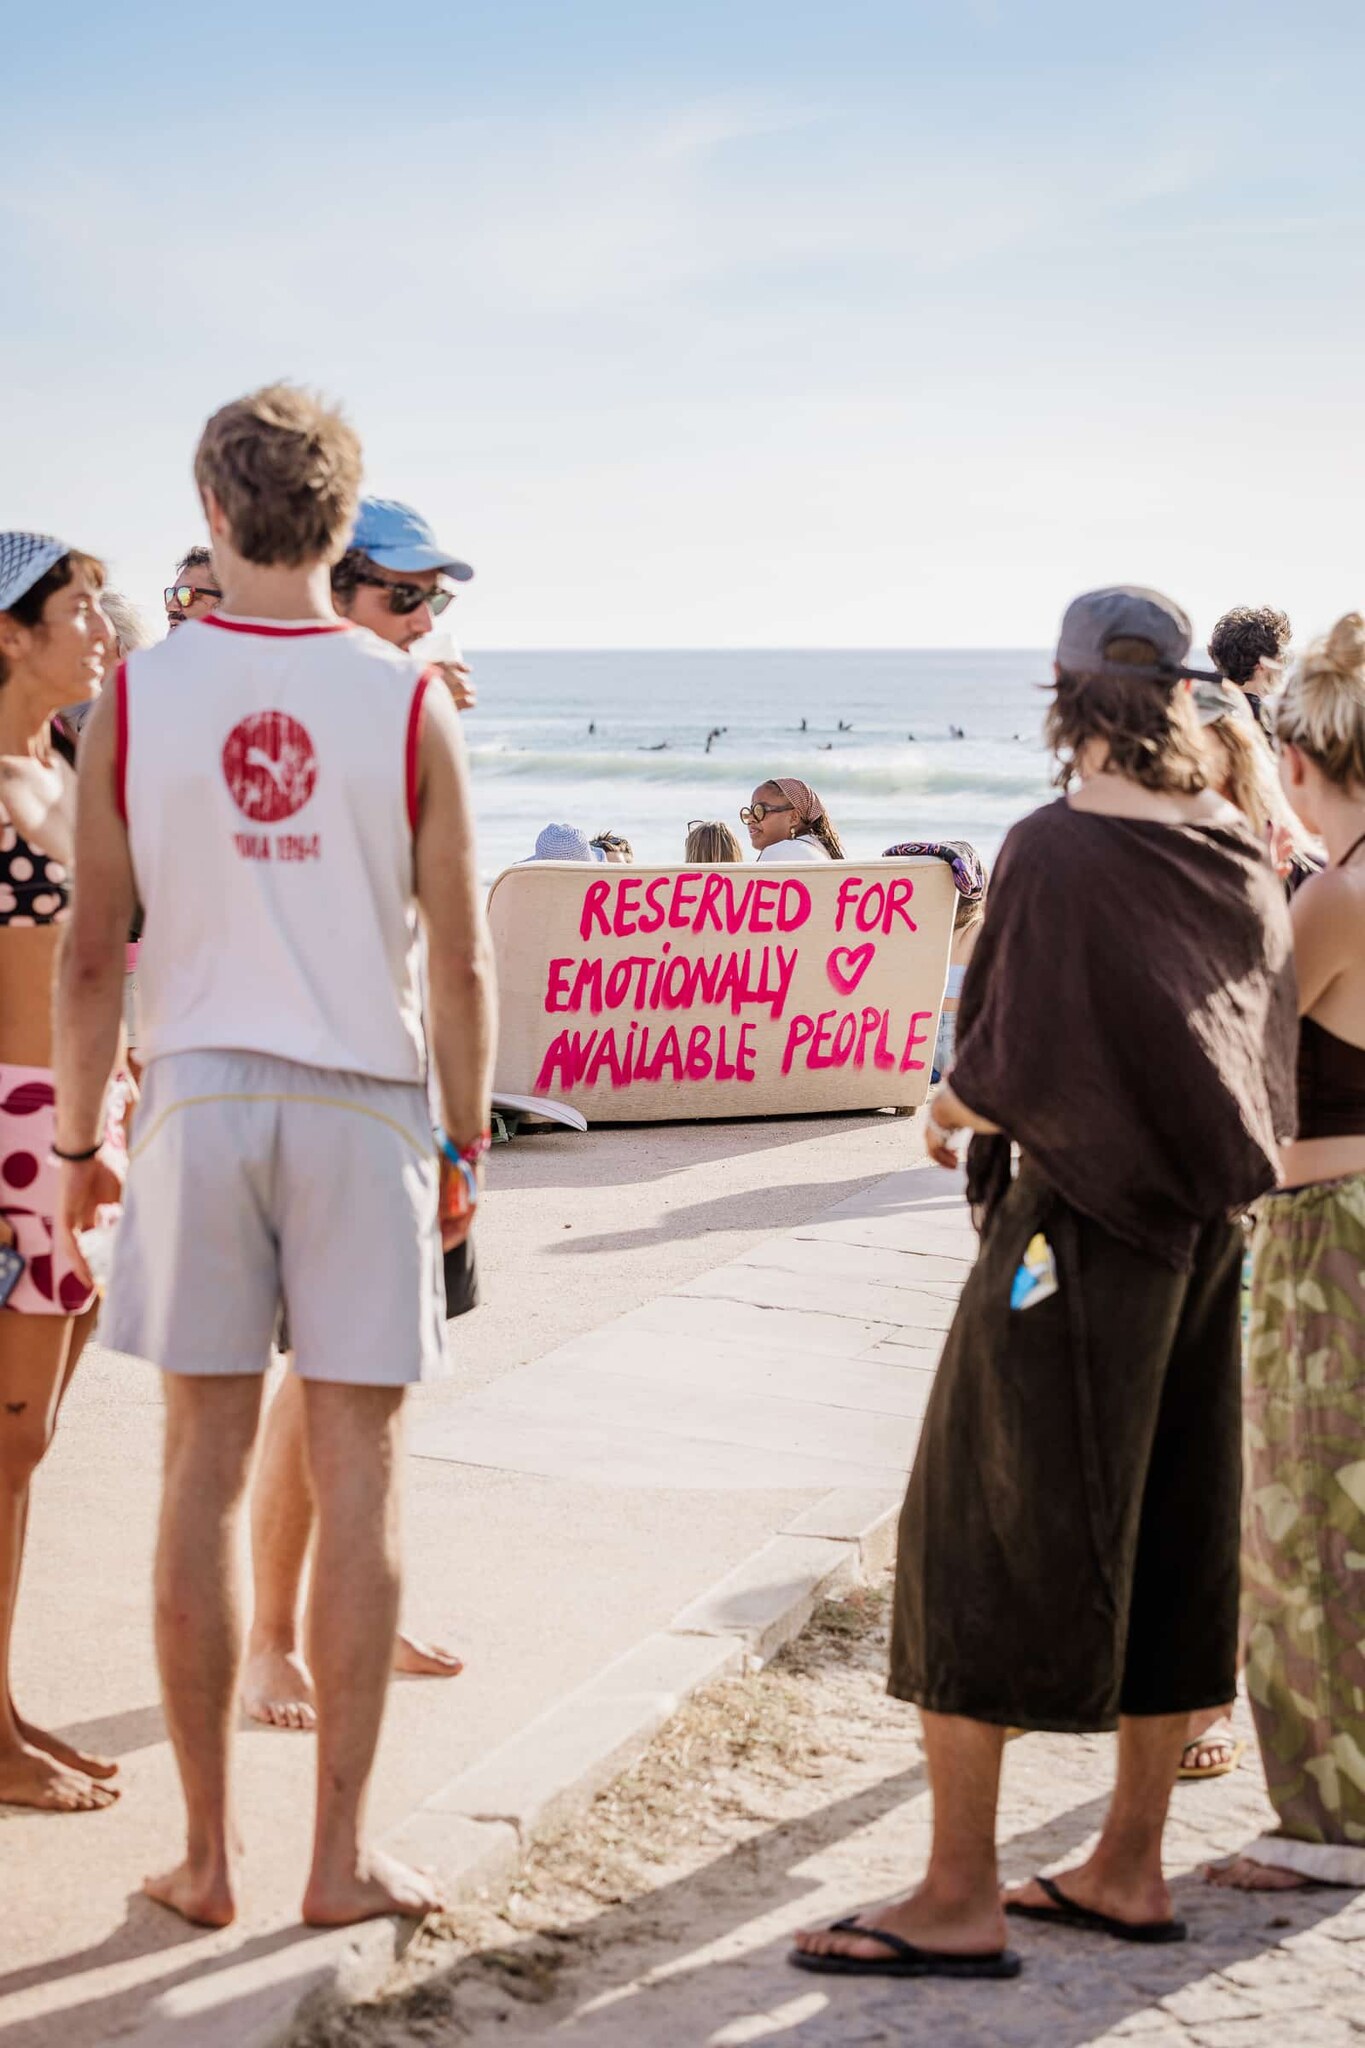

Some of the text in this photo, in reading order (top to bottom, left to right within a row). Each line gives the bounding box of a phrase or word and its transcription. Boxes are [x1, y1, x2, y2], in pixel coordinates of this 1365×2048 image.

[579, 872, 919, 942] RESERVED FOR
[780, 1007, 933, 1076] PEOPLE
